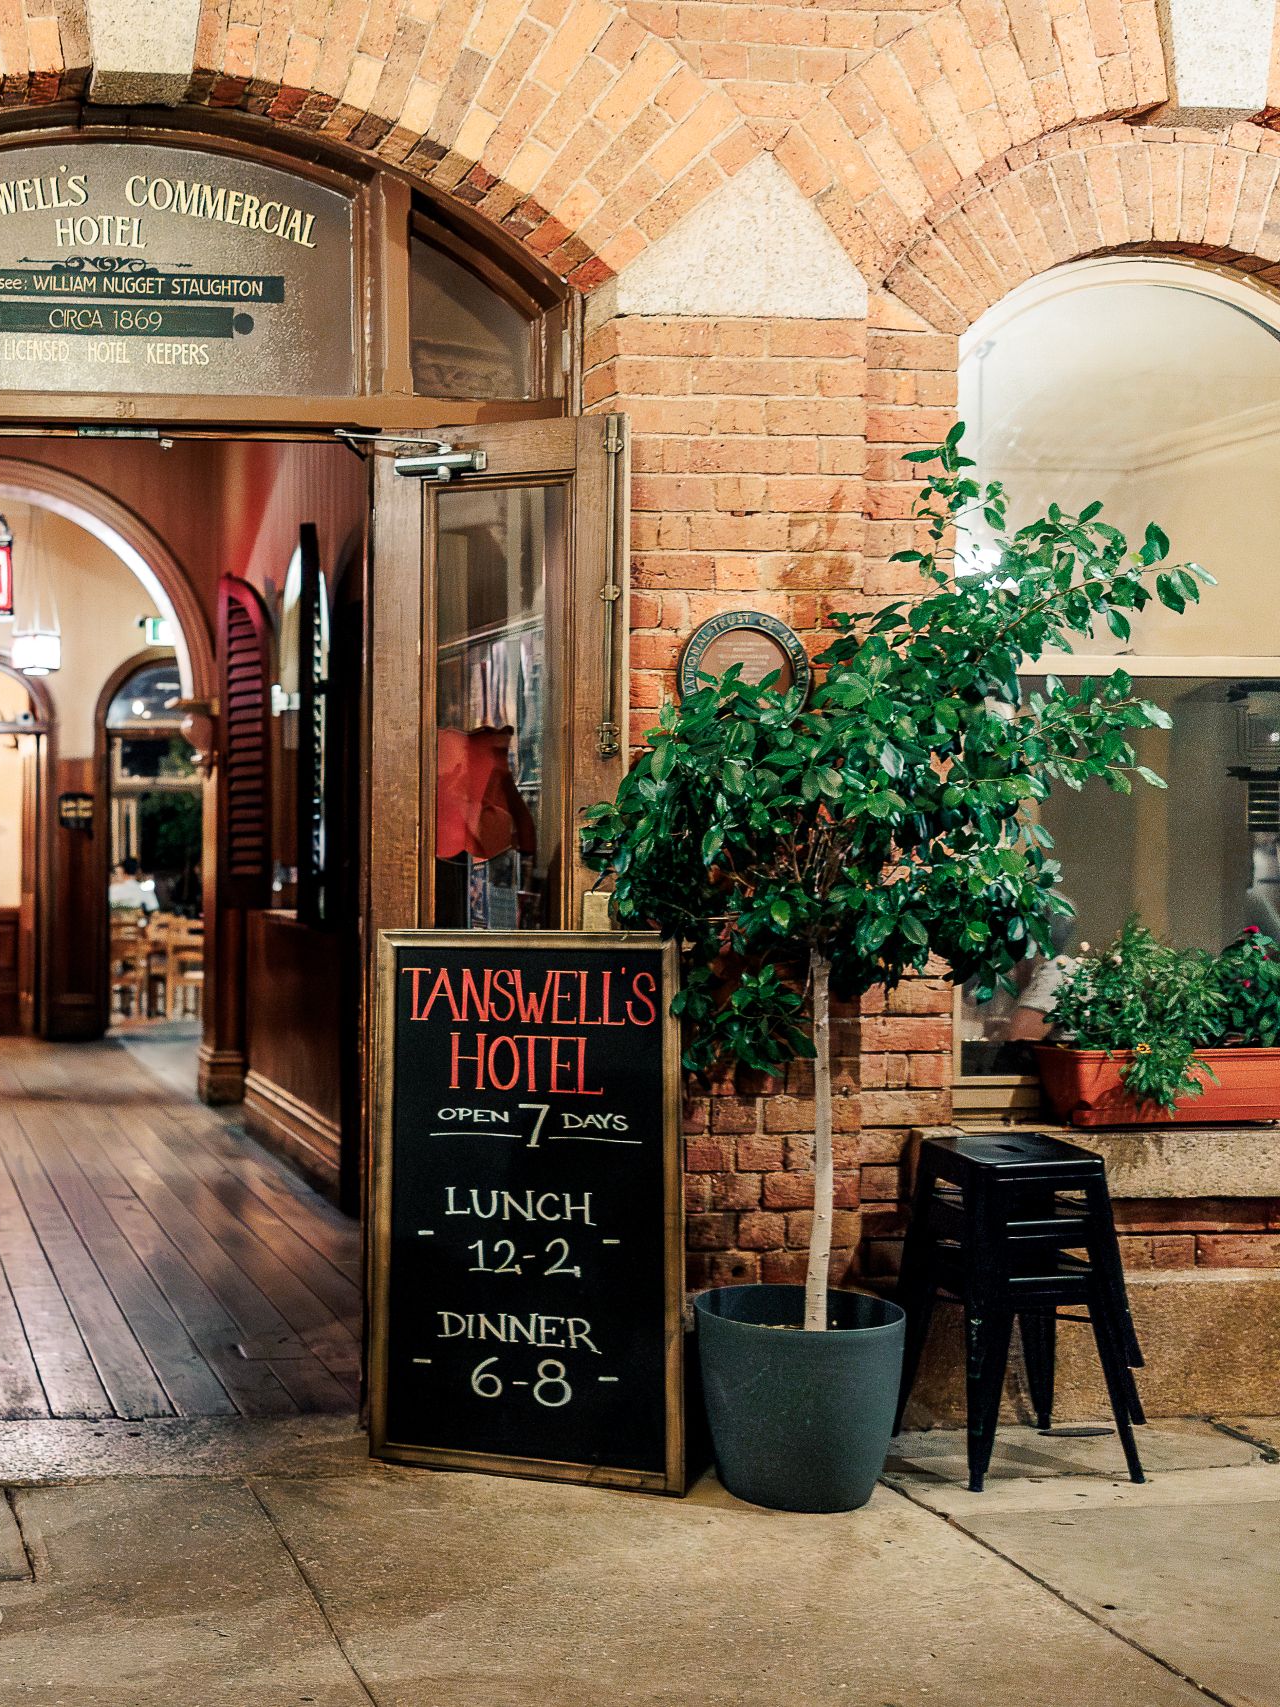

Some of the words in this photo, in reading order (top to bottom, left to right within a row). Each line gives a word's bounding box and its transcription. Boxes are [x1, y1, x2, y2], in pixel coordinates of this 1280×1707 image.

[54, 215, 148, 249] HOTEL
[124, 174, 318, 249] COMMERCIAL
[32, 275, 97, 293] WILLIAM
[102, 276, 166, 295] NUGGET
[170, 278, 264, 298] STAUGHTON
[47, 308, 104, 329] CIRCA
[112, 309, 163, 331] 1869
[3, 340, 71, 363] LICENSED
[87, 341, 131, 364] HOTEL
[146, 343, 210, 366] KEEPERS
[401, 966, 657, 1027] TANSWELL'S
[448, 1031, 604, 1095] HOTEL
[436, 1106, 510, 1124] OPEN
[518, 1103, 551, 1148] 7
[561, 1112, 629, 1133] DAYS
[444, 1186, 597, 1226] LUNCH
[436, 1311, 603, 1354] DINNER
[470, 1356, 573, 1408] 6-8
